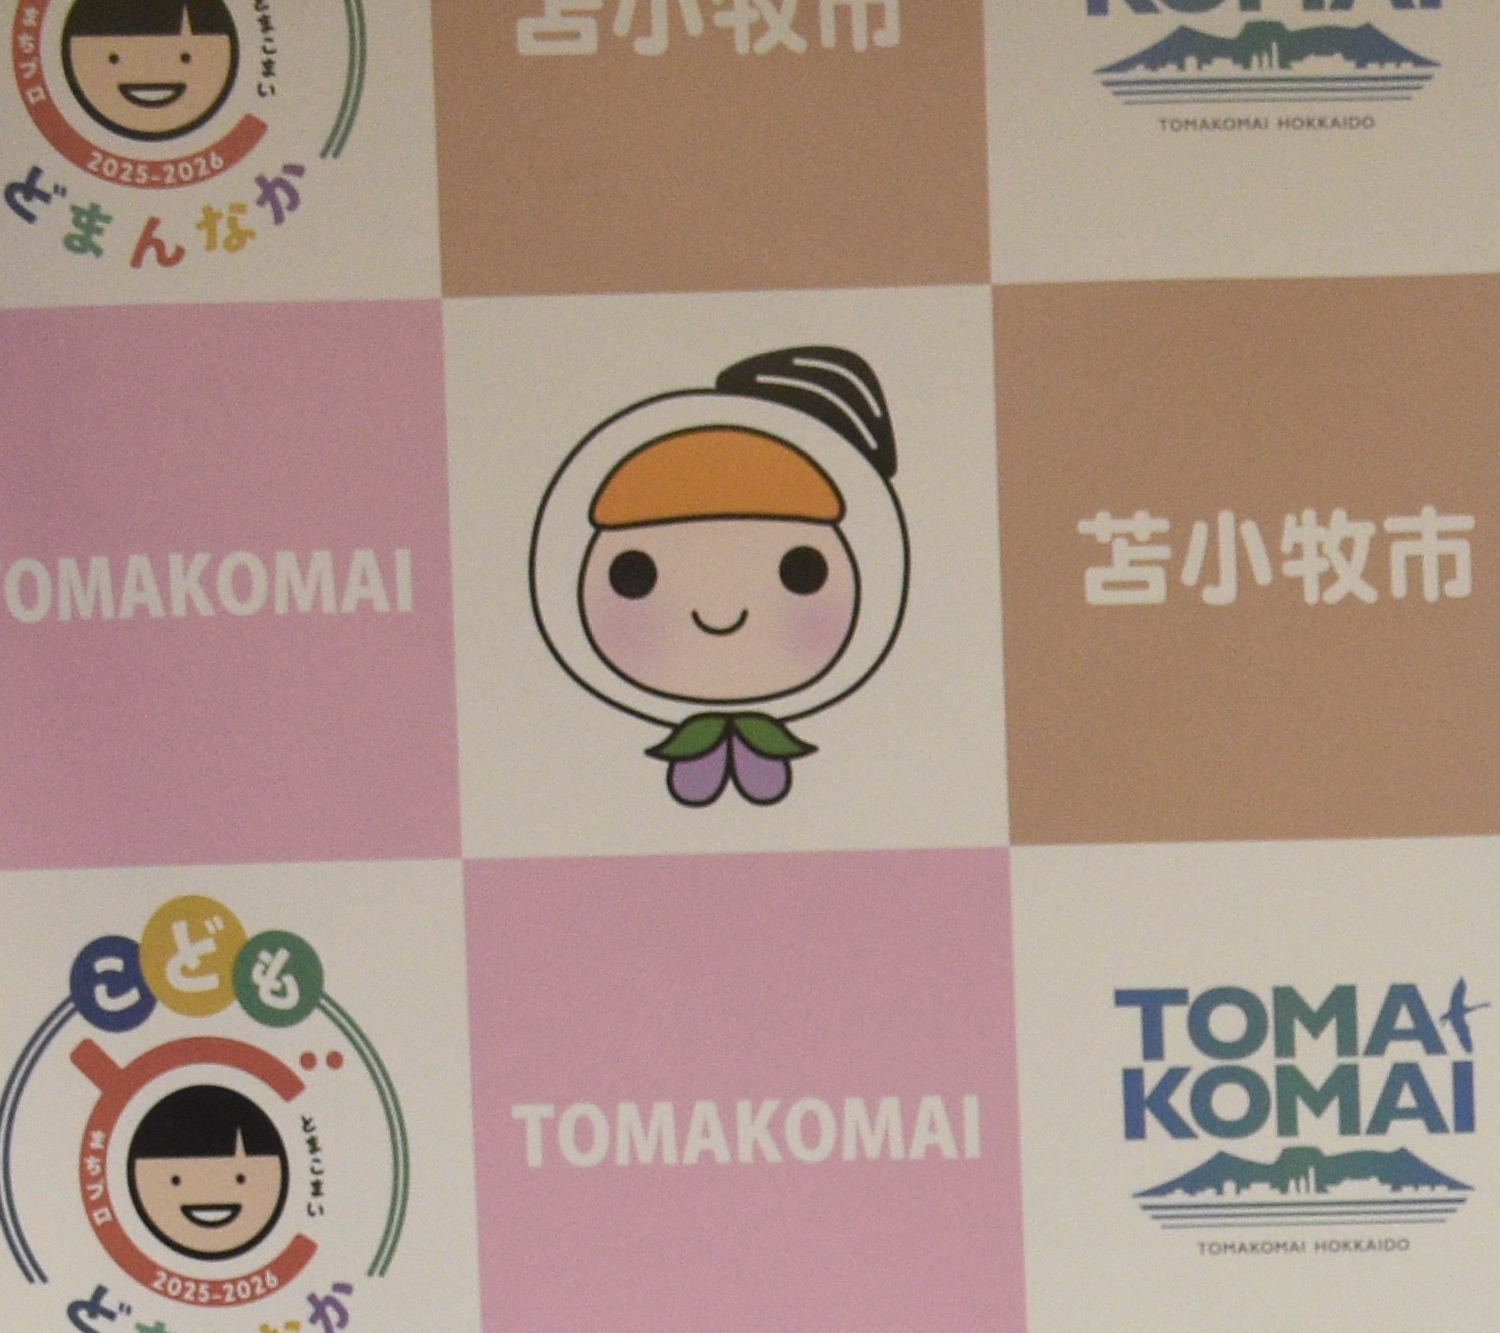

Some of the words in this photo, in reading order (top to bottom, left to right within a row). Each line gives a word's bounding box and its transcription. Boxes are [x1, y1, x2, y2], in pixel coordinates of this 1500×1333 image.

[1158, 116, 1270, 134] TOMAKOMAI
[1277, 115, 1375, 132] HOKKAIDO
[85, 149, 226, 186] 2025-2026
[1, 163, 307, 269] どまんなか
[1077, 505, 1475, 605] 苫小牧市
[89, 915, 300, 1010] こども
[1113, 981, 1447, 1063] TOMA
[512, 1094, 981, 1168] TOMAKOMAI
[1121, 1058, 1477, 1142] KOMAI
[149, 1268, 280, 1304] 2025-2026
[1197, 1240, 1306, 1257] TOMAKOMAI
[1313, 1238, 1411, 1255] HOKKAIDO
